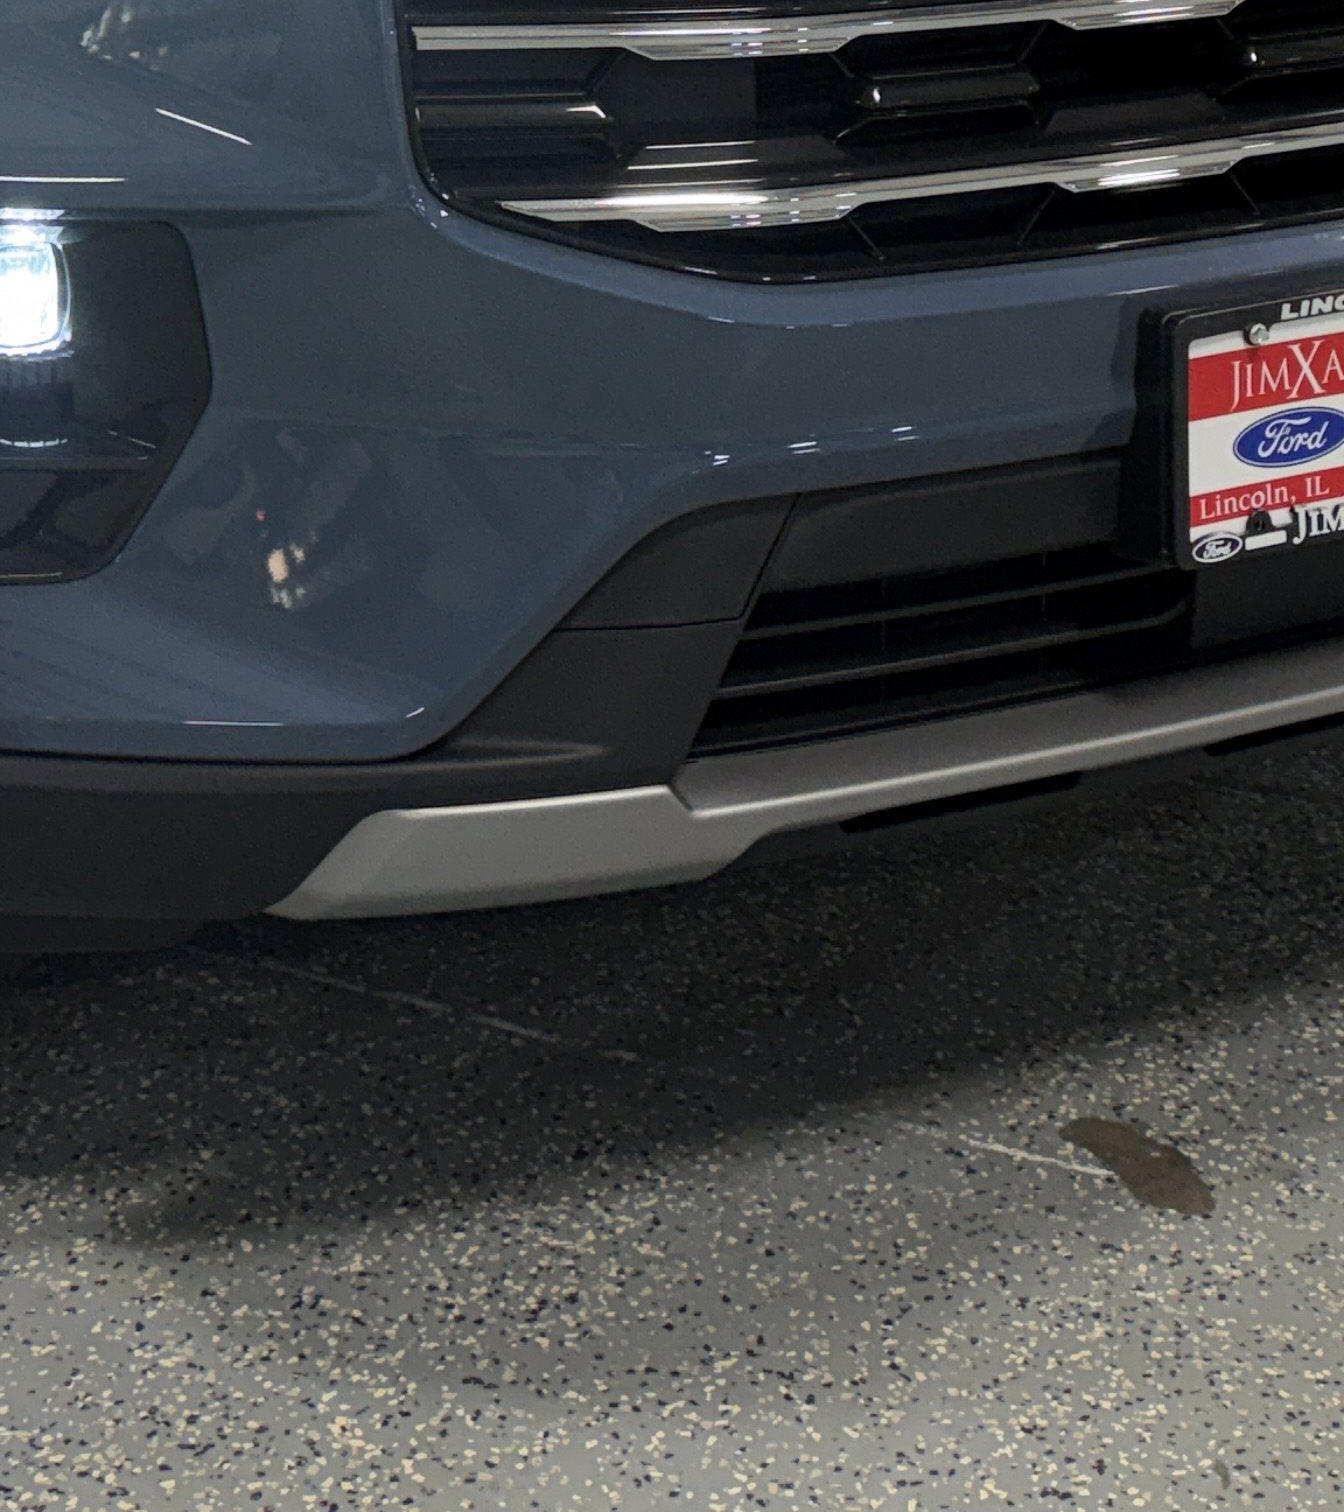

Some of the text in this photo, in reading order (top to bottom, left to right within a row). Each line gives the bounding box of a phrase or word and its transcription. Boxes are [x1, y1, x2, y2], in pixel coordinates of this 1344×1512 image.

[1258, 417, 1327, 458] Ford
[1199, 476, 1330, 521] Lincoln, IL
